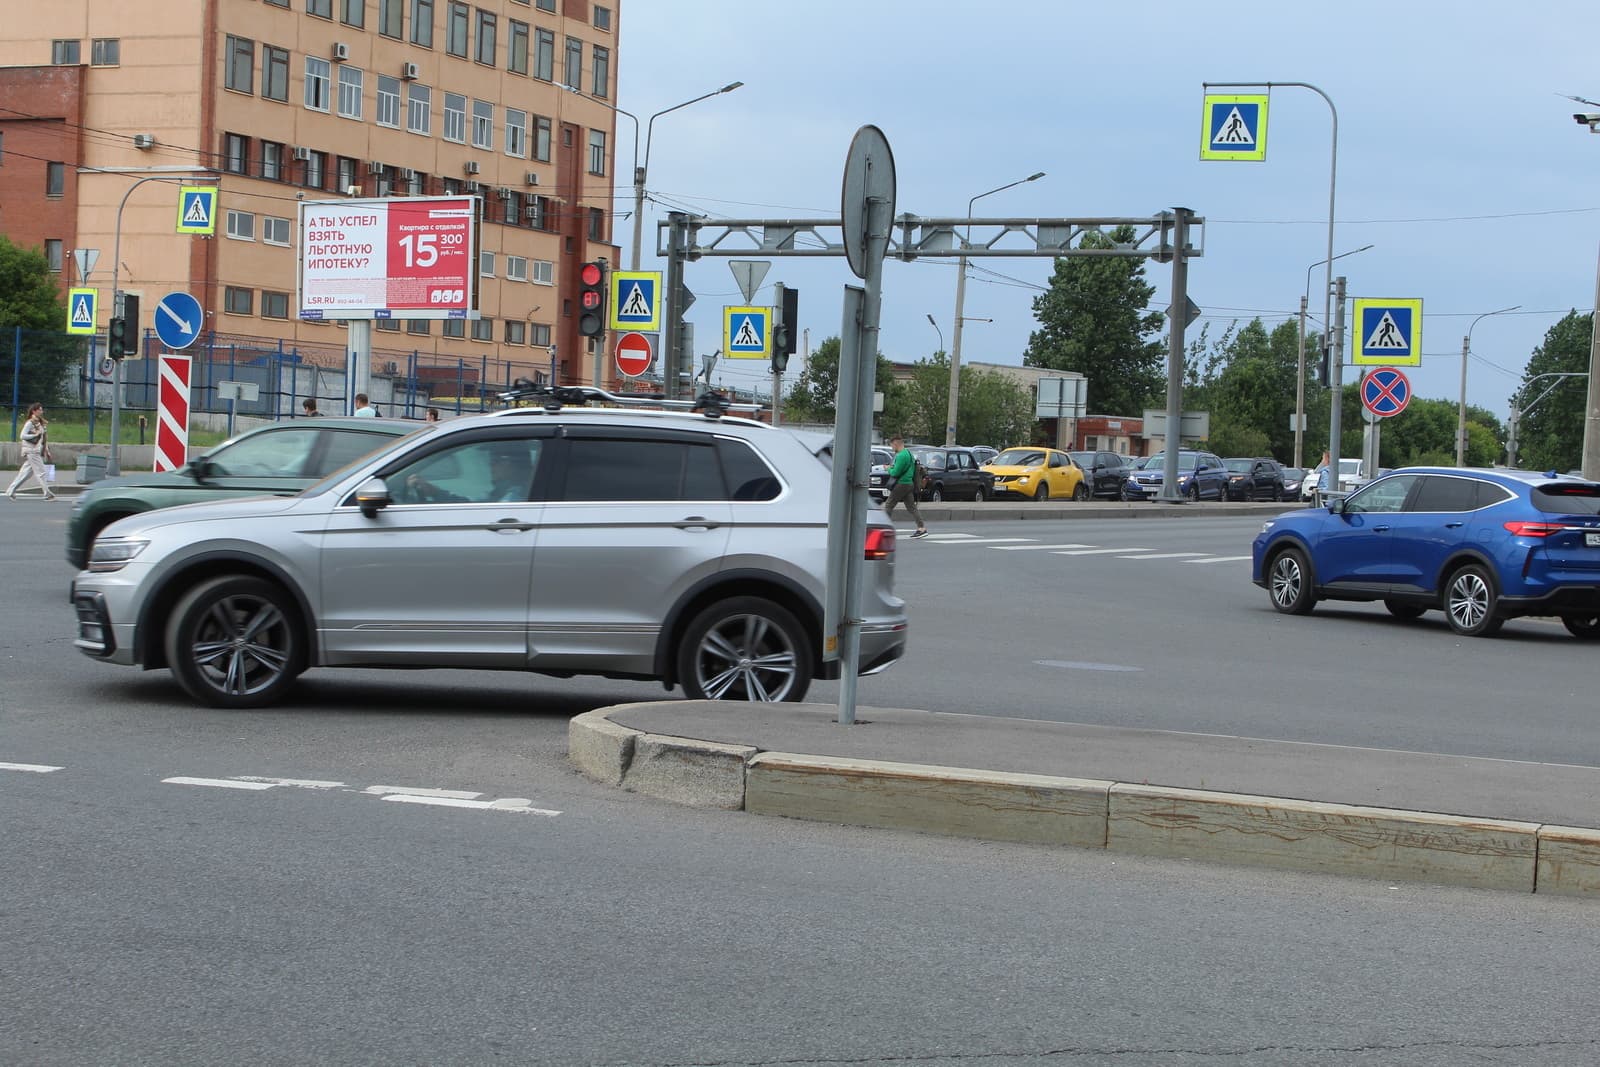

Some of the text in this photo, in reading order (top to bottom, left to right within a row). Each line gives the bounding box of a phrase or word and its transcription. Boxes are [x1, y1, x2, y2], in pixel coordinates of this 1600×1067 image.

[309, 215, 377, 227] А ТЫ УСПЕЛ
[399, 224, 429, 232] Квартира
[435, 223, 465, 231] отделкой
[309, 230, 345, 241] ВЗЯТЬ
[308, 244, 373, 255] ЛЬГОТНУЮ
[398, 233, 438, 268] 15
[308, 258, 369, 269] ИПОТЕКУ?
[307, 296, 335, 305] LSR.RU
